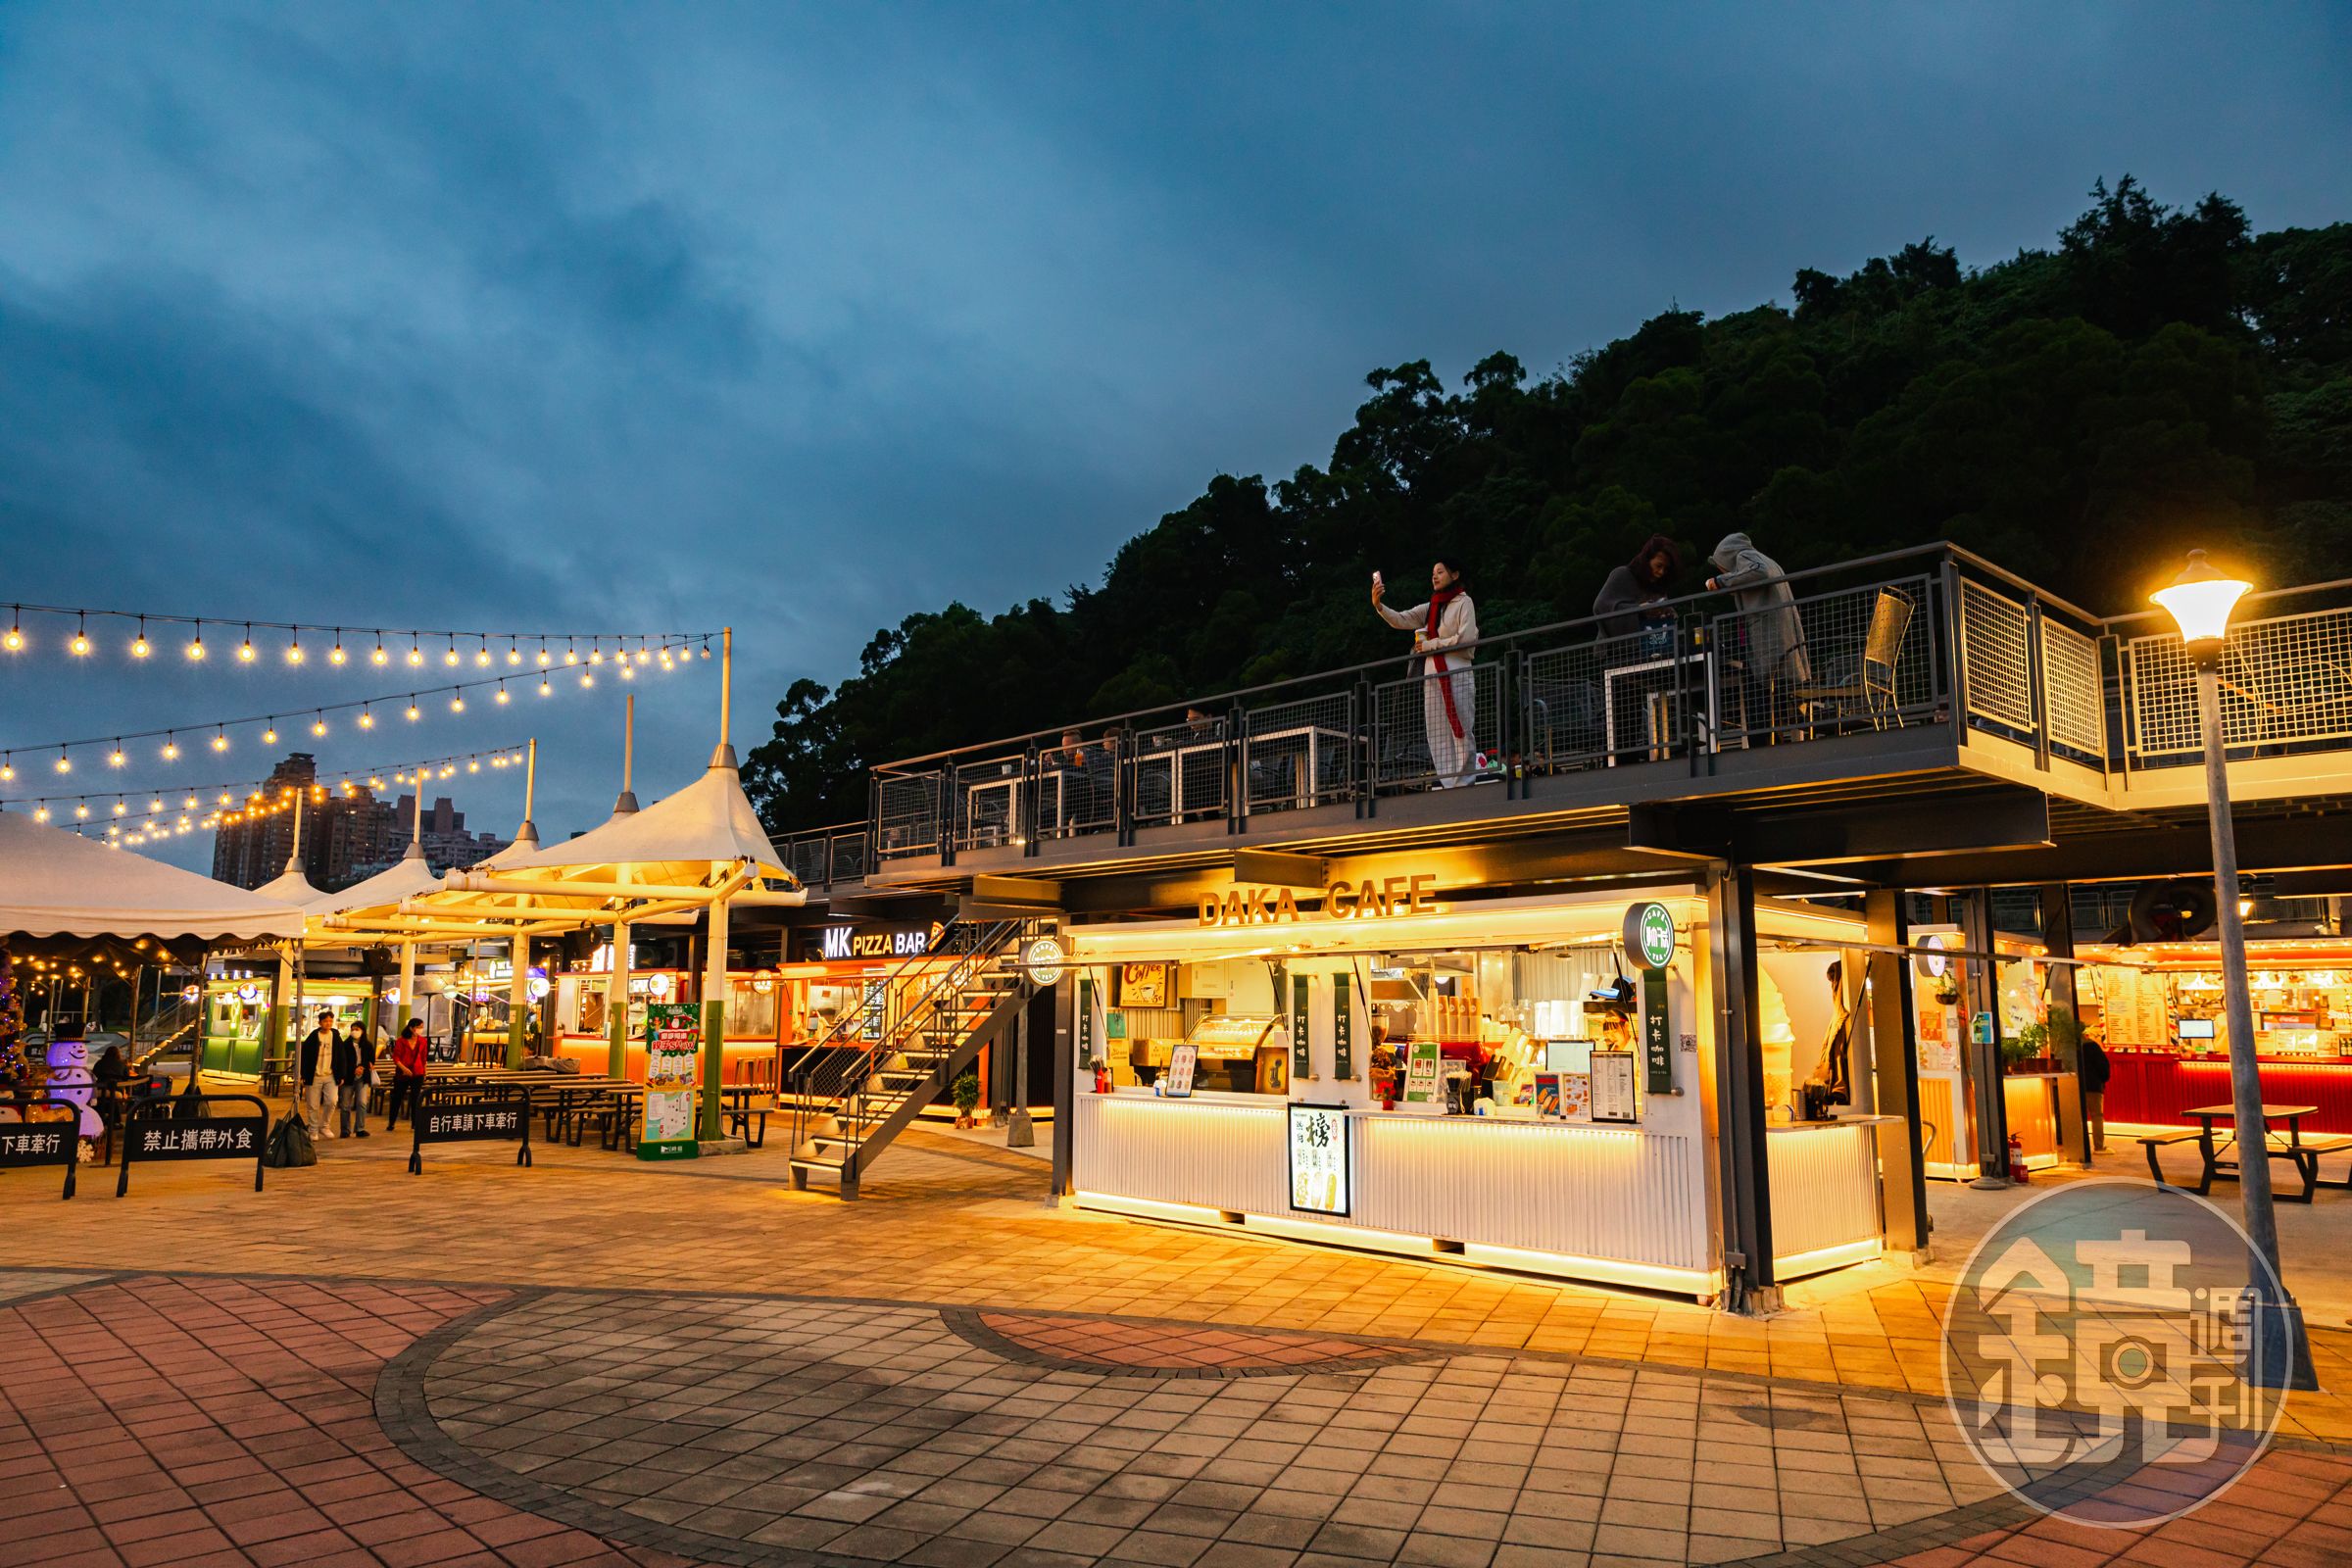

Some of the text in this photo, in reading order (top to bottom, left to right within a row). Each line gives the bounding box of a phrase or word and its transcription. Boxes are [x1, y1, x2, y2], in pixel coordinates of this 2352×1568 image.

[1199, 874, 1437, 927] DAKA CAFE
[825, 927, 853, 957] MK
[853, 935, 893, 956] PIZZA
[1124, 964, 1162, 985] Coffee
[1296, 1014, 1306, 1057] 打卡咖啡
[1337, 1014, 1347, 1057] 打卡咖啡
[1649, 1014, 1665, 1066] 打卡咖啡
[430, 1112, 517, 1133] 自行車請下車牽行
[1, 1133, 61, 1154] 下車牽行
[143, 1127, 253, 1151] 禁止攜帶外食
